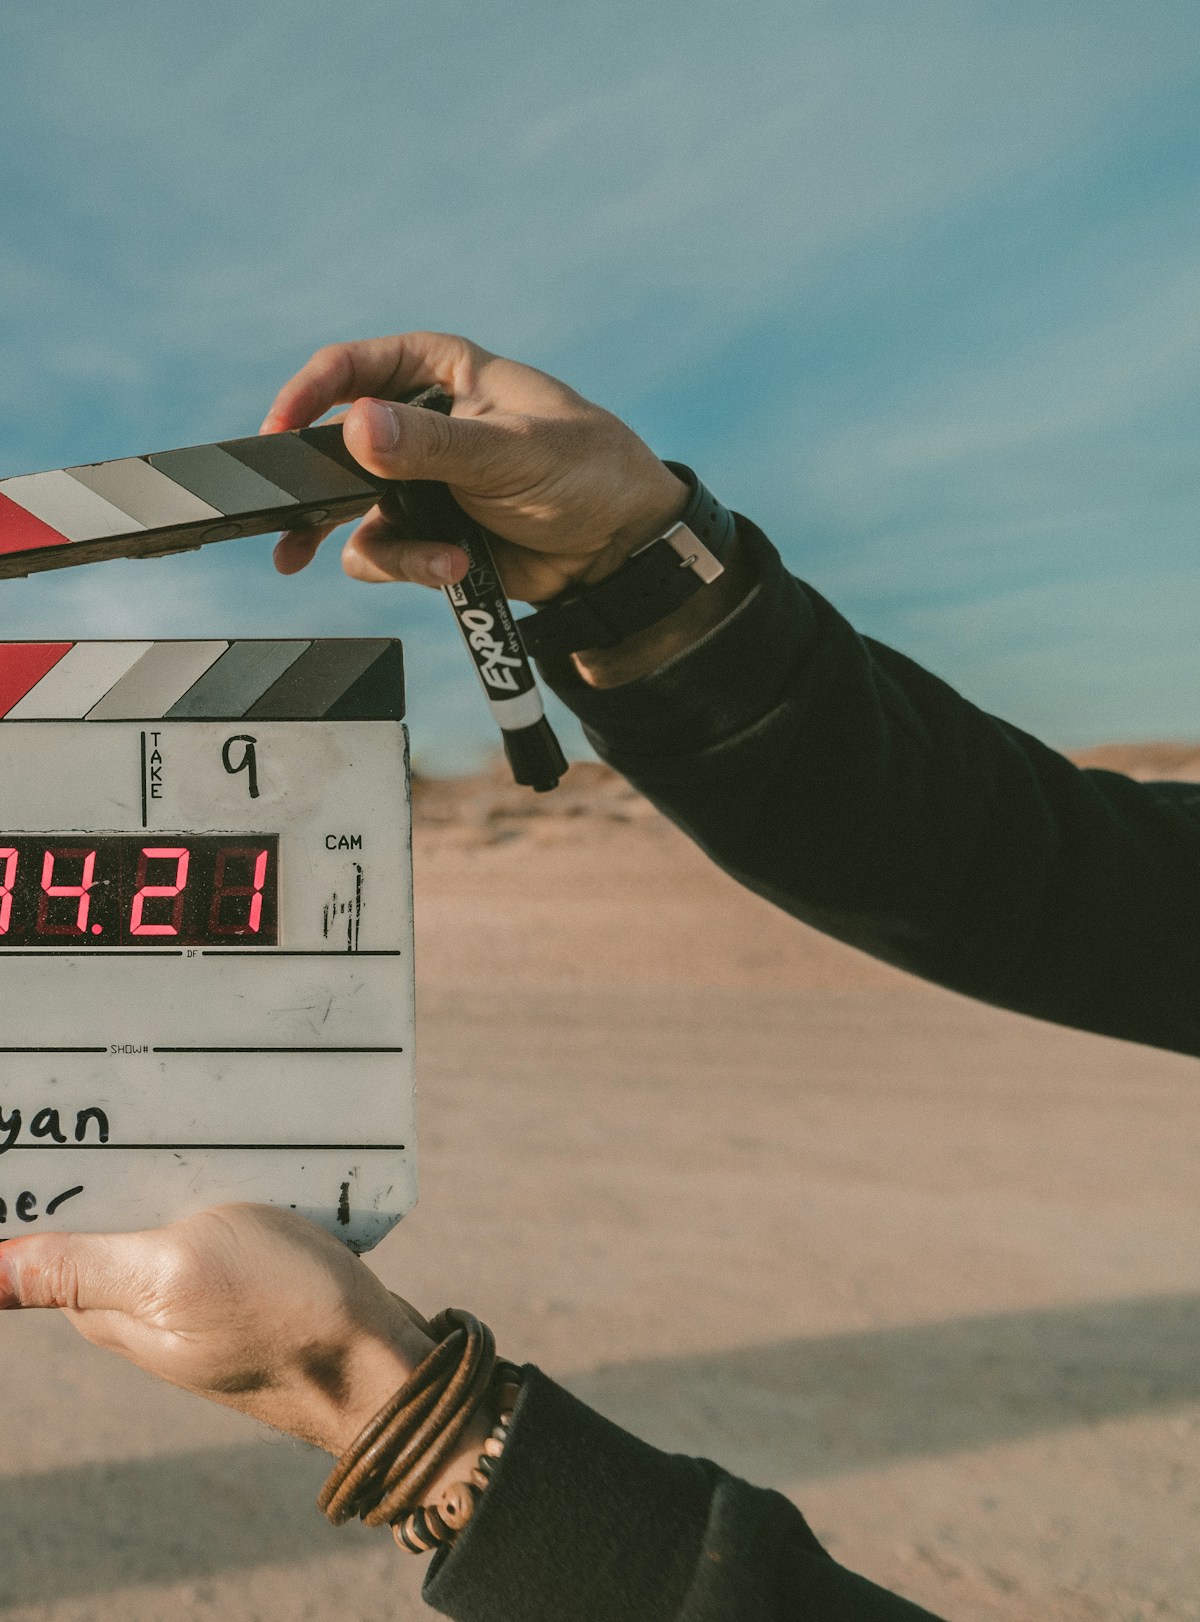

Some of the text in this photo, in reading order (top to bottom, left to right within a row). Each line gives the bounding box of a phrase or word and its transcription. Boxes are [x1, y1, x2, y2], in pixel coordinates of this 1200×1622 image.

[460, 609, 522, 691] EXPO
[151, 732, 162, 798] TAKE
[222, 735, 259, 798] 9
[326, 835, 361, 850] CAM
